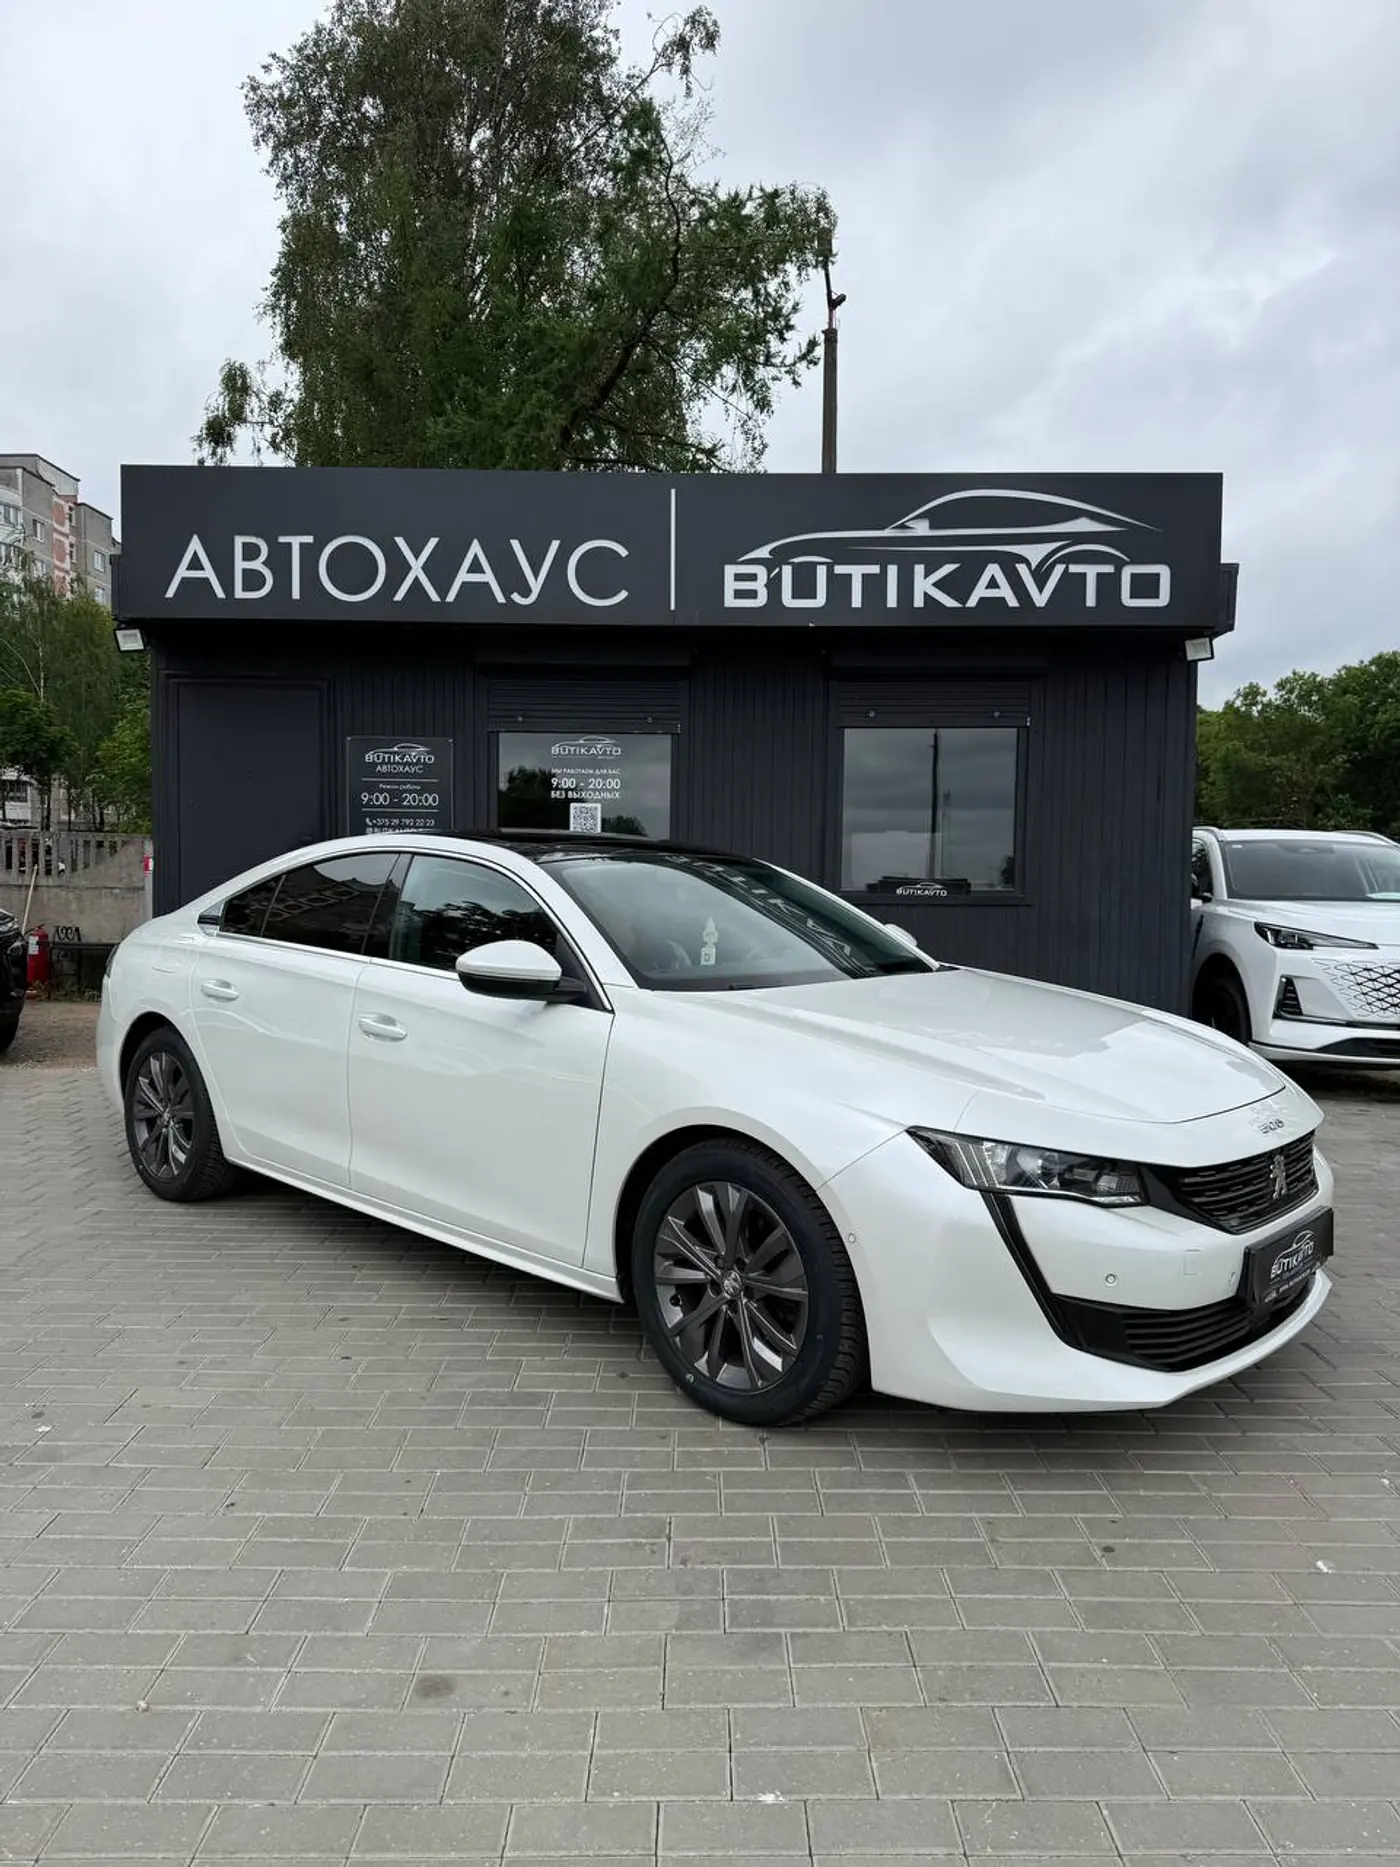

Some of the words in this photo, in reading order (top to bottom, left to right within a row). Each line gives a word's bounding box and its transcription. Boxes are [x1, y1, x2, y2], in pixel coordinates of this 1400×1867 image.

[164, 533, 630, 607] АВТОХАУС
[723, 562, 1171, 609] BUTIKAVTO
[551, 746, 621, 755] BUTIKAVTO
[365, 753, 434, 763] BUTIKAVTO
[375, 764, 424, 773] АВТОХАУС
[551, 777, 576, 789] 9:00
[588, 778, 621, 789] 20:00
[361, 792, 390, 805] 9:00
[402, 793, 439, 806] 20:00
[551, 790, 565, 799] БЕЗ
[567, 790, 620, 799] ВЫХОДНЫХ
[895, 888, 948, 897] BUTIKAVTO
